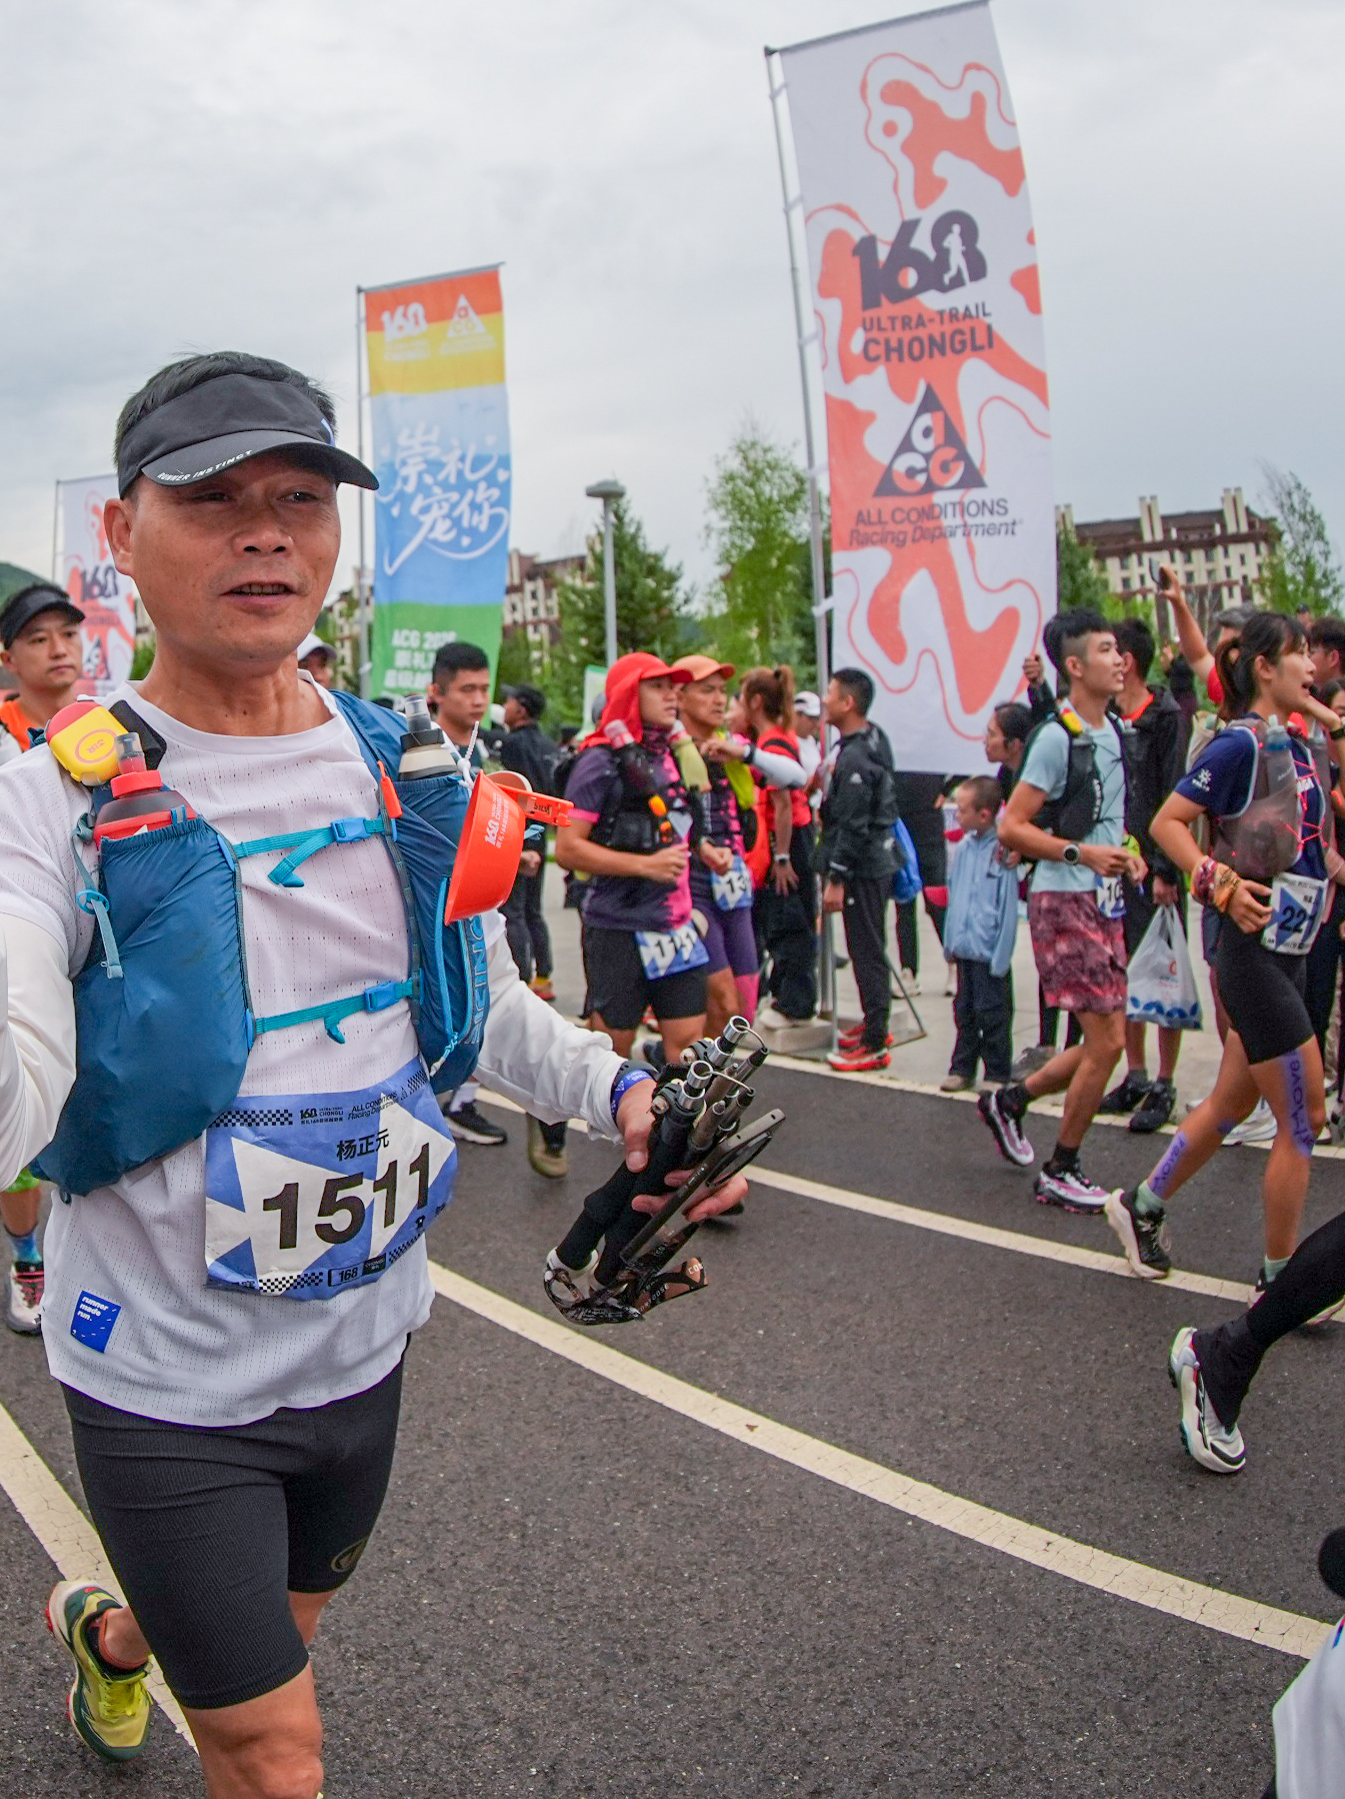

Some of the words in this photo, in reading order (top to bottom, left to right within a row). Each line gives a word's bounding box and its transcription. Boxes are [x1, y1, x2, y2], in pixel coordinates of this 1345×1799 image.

[852, 209, 988, 312] 168
[862, 301, 992, 333] ULTRA-TRAIL
[862, 323, 994, 363] CHONGLI
[157, 472, 192, 482] RUNNER
[193, 449, 253, 479] INSTINCT
[855, 508, 889, 527] ALL
[891, 498, 1009, 526] CONDITIONS
[849, 527, 908, 547] Racing
[911, 518, 1018, 544] Department
[299, 1107, 318, 1120] 168
[347, 1108, 371, 1121] Racing
[351, 1103, 366, 1114] ALL
[337, 1128, 390, 1162] 杨正元
[262, 1142, 430, 1250] 1511
[338, 1267, 359, 1282] 168
[77, 1310, 93, 1322] run.
[79, 1303, 102, 1317] made
[82, 1296, 109, 1311] runner
